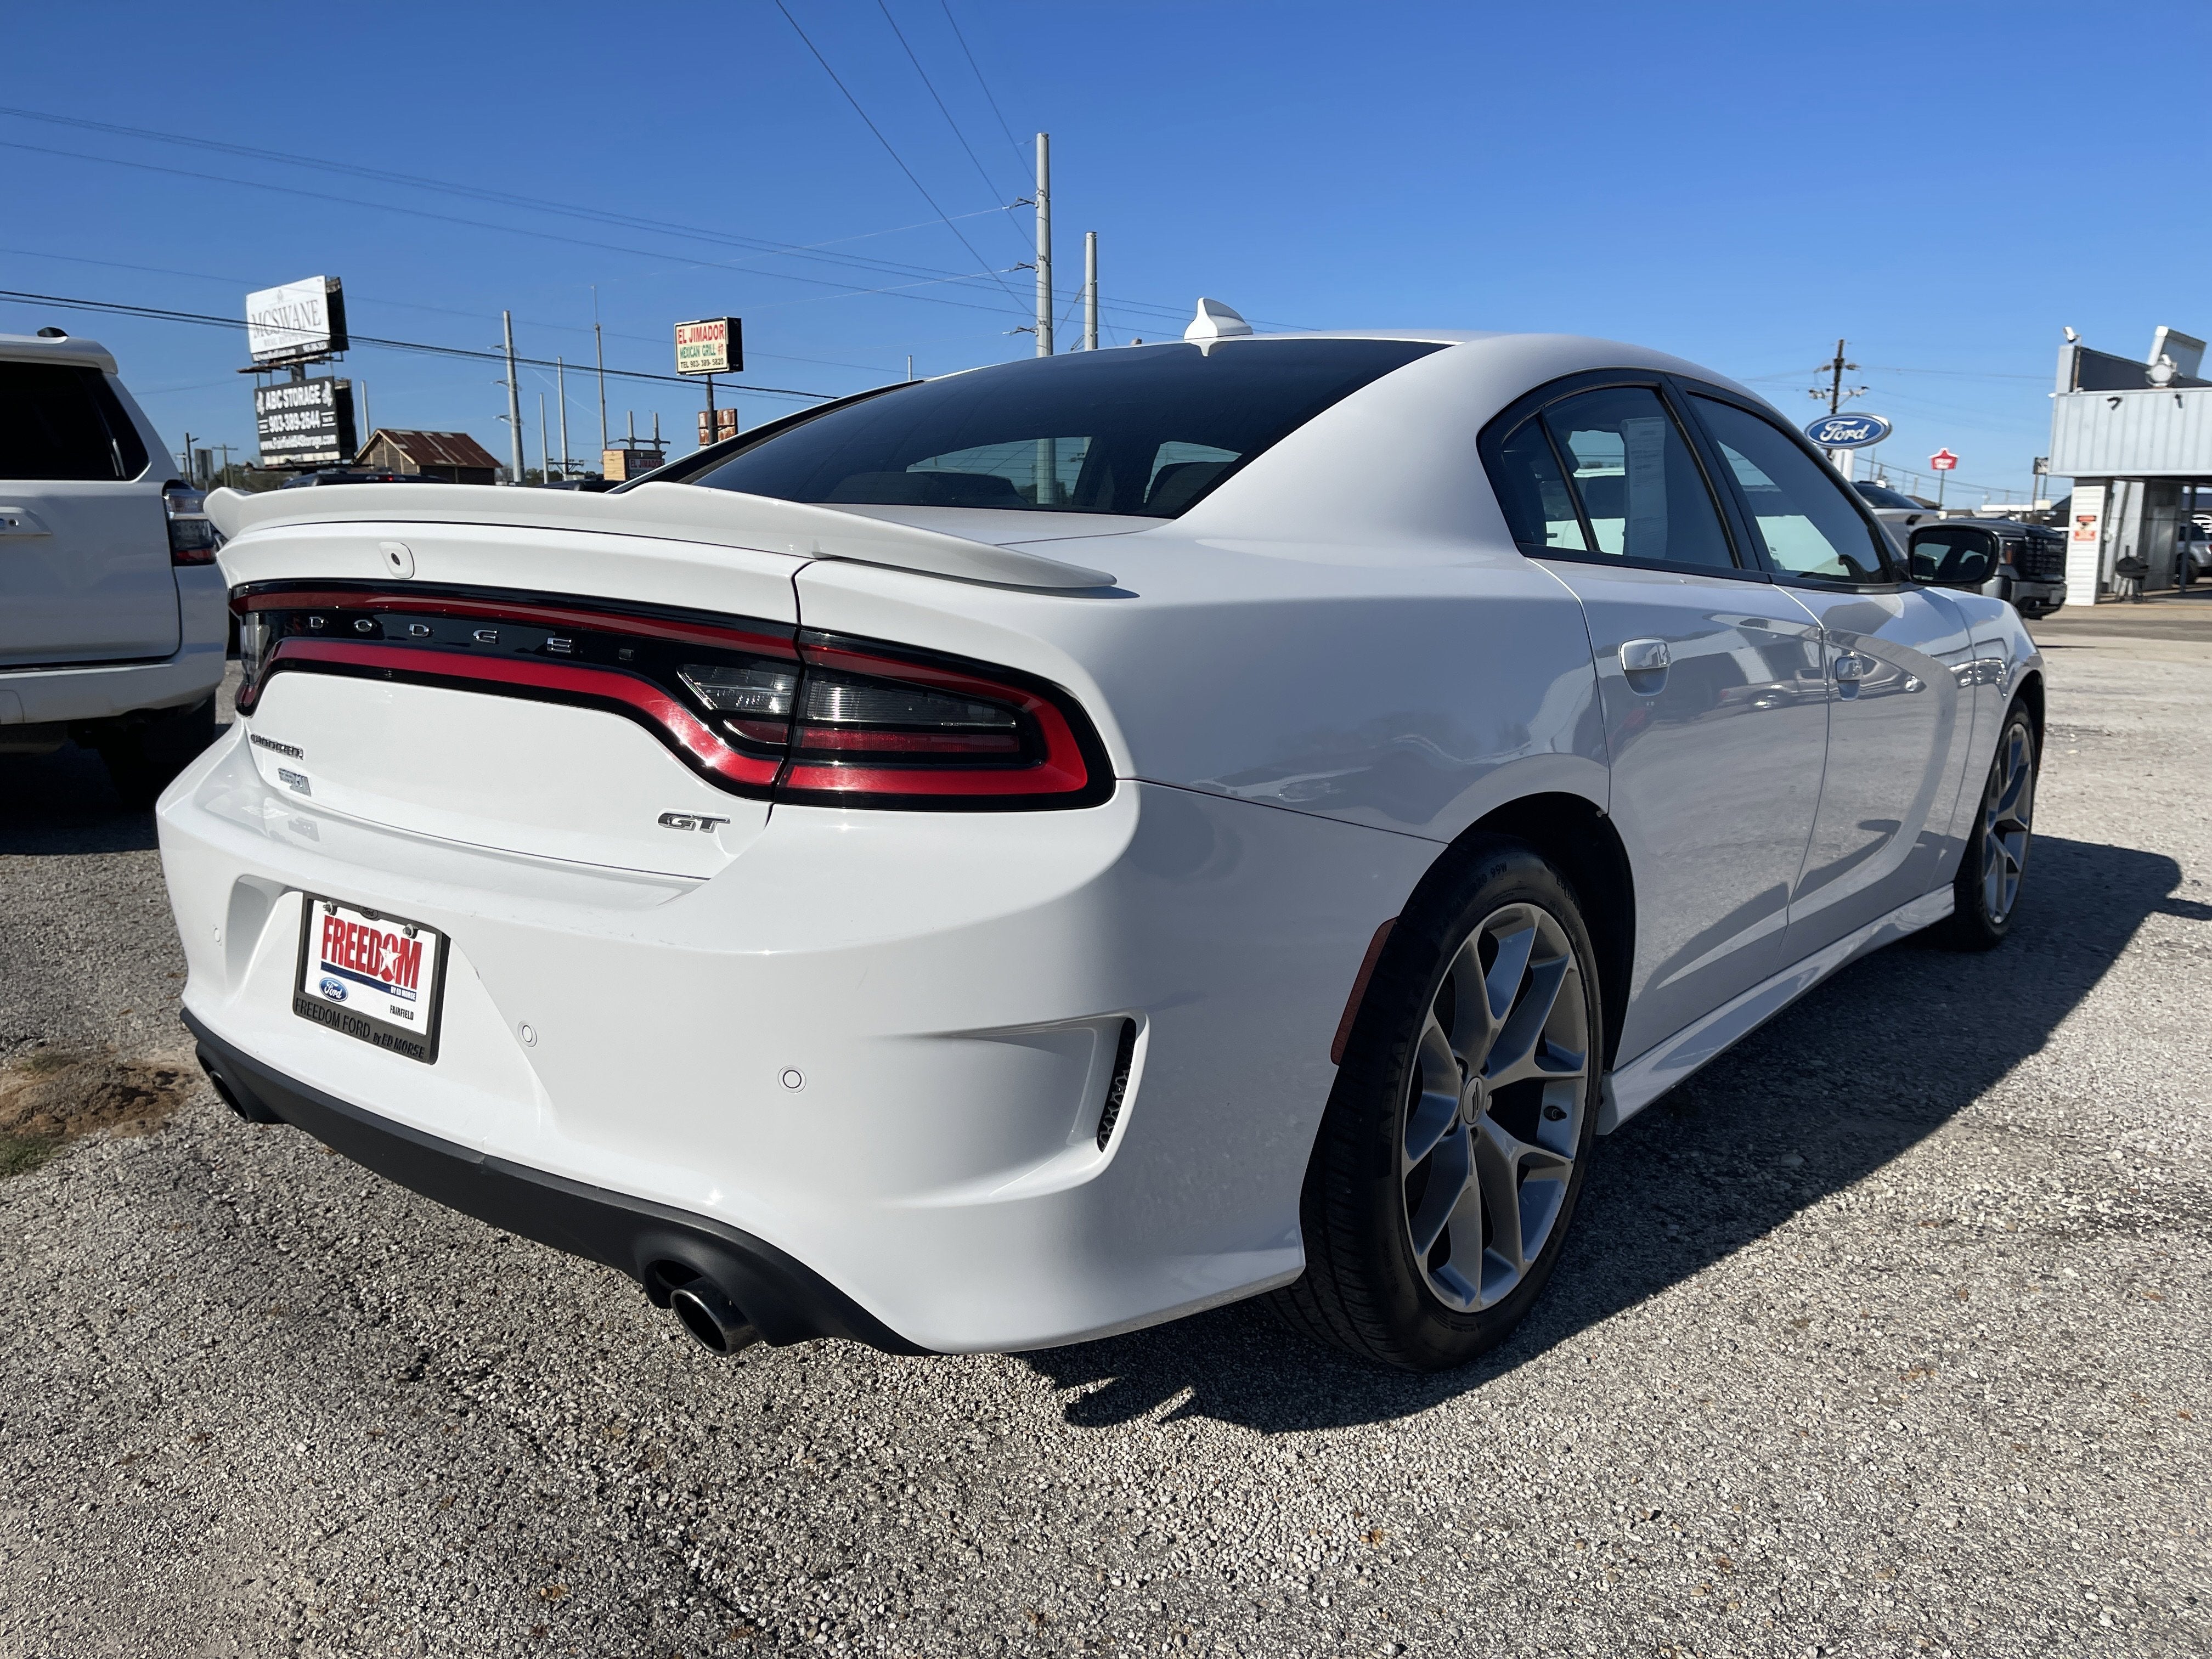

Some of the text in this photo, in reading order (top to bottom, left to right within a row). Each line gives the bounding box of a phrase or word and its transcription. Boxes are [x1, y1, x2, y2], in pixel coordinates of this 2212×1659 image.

[678, 324, 725, 345] EL JIMADOR
[680, 345, 700, 359] MEXICAN
[702, 343, 716, 357] GRILL
[266, 384, 321, 410] ABC STORAGE
[1819, 420, 1871, 442] Ford
[309, 616, 572, 653] DODGE
[658, 812, 731, 833] GT
[321, 915, 423, 990] FREEDOM
[324, 981, 342, 998] Ford
[396, 988, 402, 996] ED
[402, 989, 416, 1000] MORSE
[390, 1005, 414, 1020] FAIRFIELD
[295, 997, 341, 1028] FREEDOM
[342, 1015, 370, 1037] FORD
[382, 1033, 393, 1046] ED
[394, 1037, 426, 1059] MORSE
